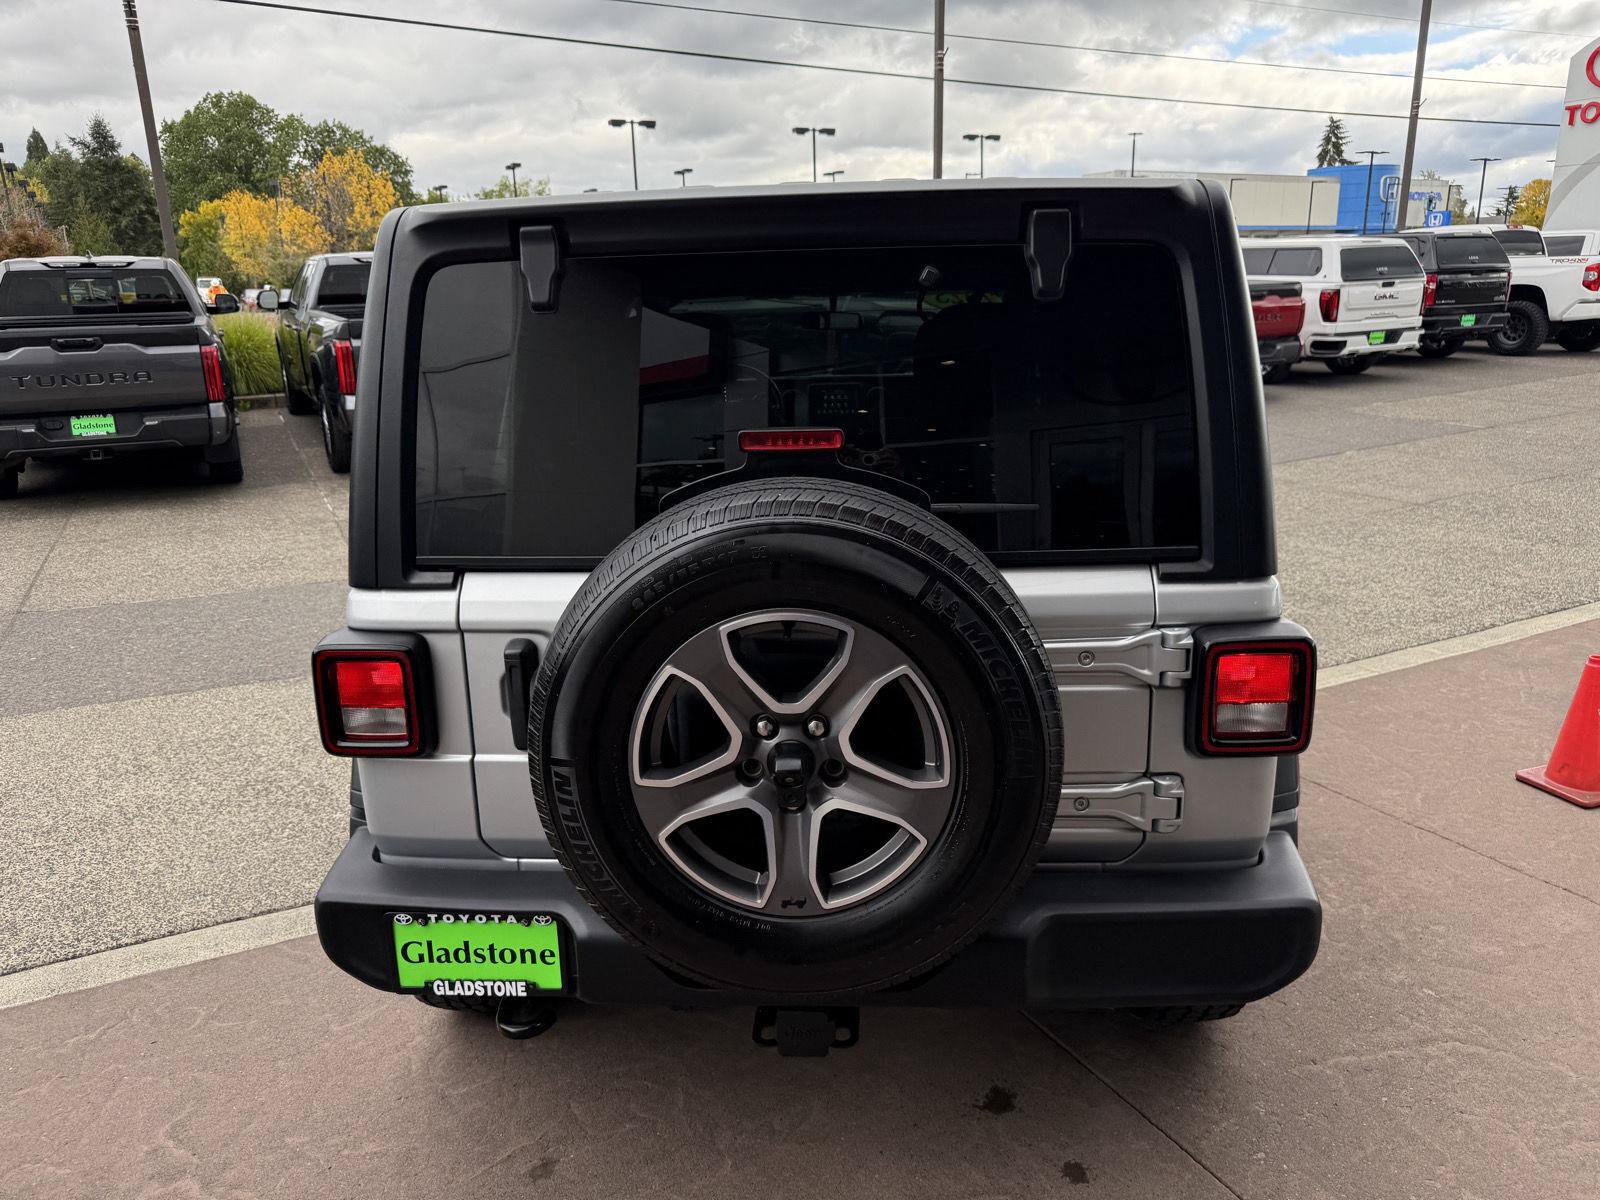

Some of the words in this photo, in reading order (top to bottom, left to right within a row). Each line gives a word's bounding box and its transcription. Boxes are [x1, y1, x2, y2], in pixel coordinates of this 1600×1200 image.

[9, 370, 154, 389] TUNDRA
[73, 422, 113, 430] Gladstone
[427, 913, 518, 924] TOYOTA
[400, 940, 556, 965] Gladstone
[432, 980, 528, 997] GLADSTONE
